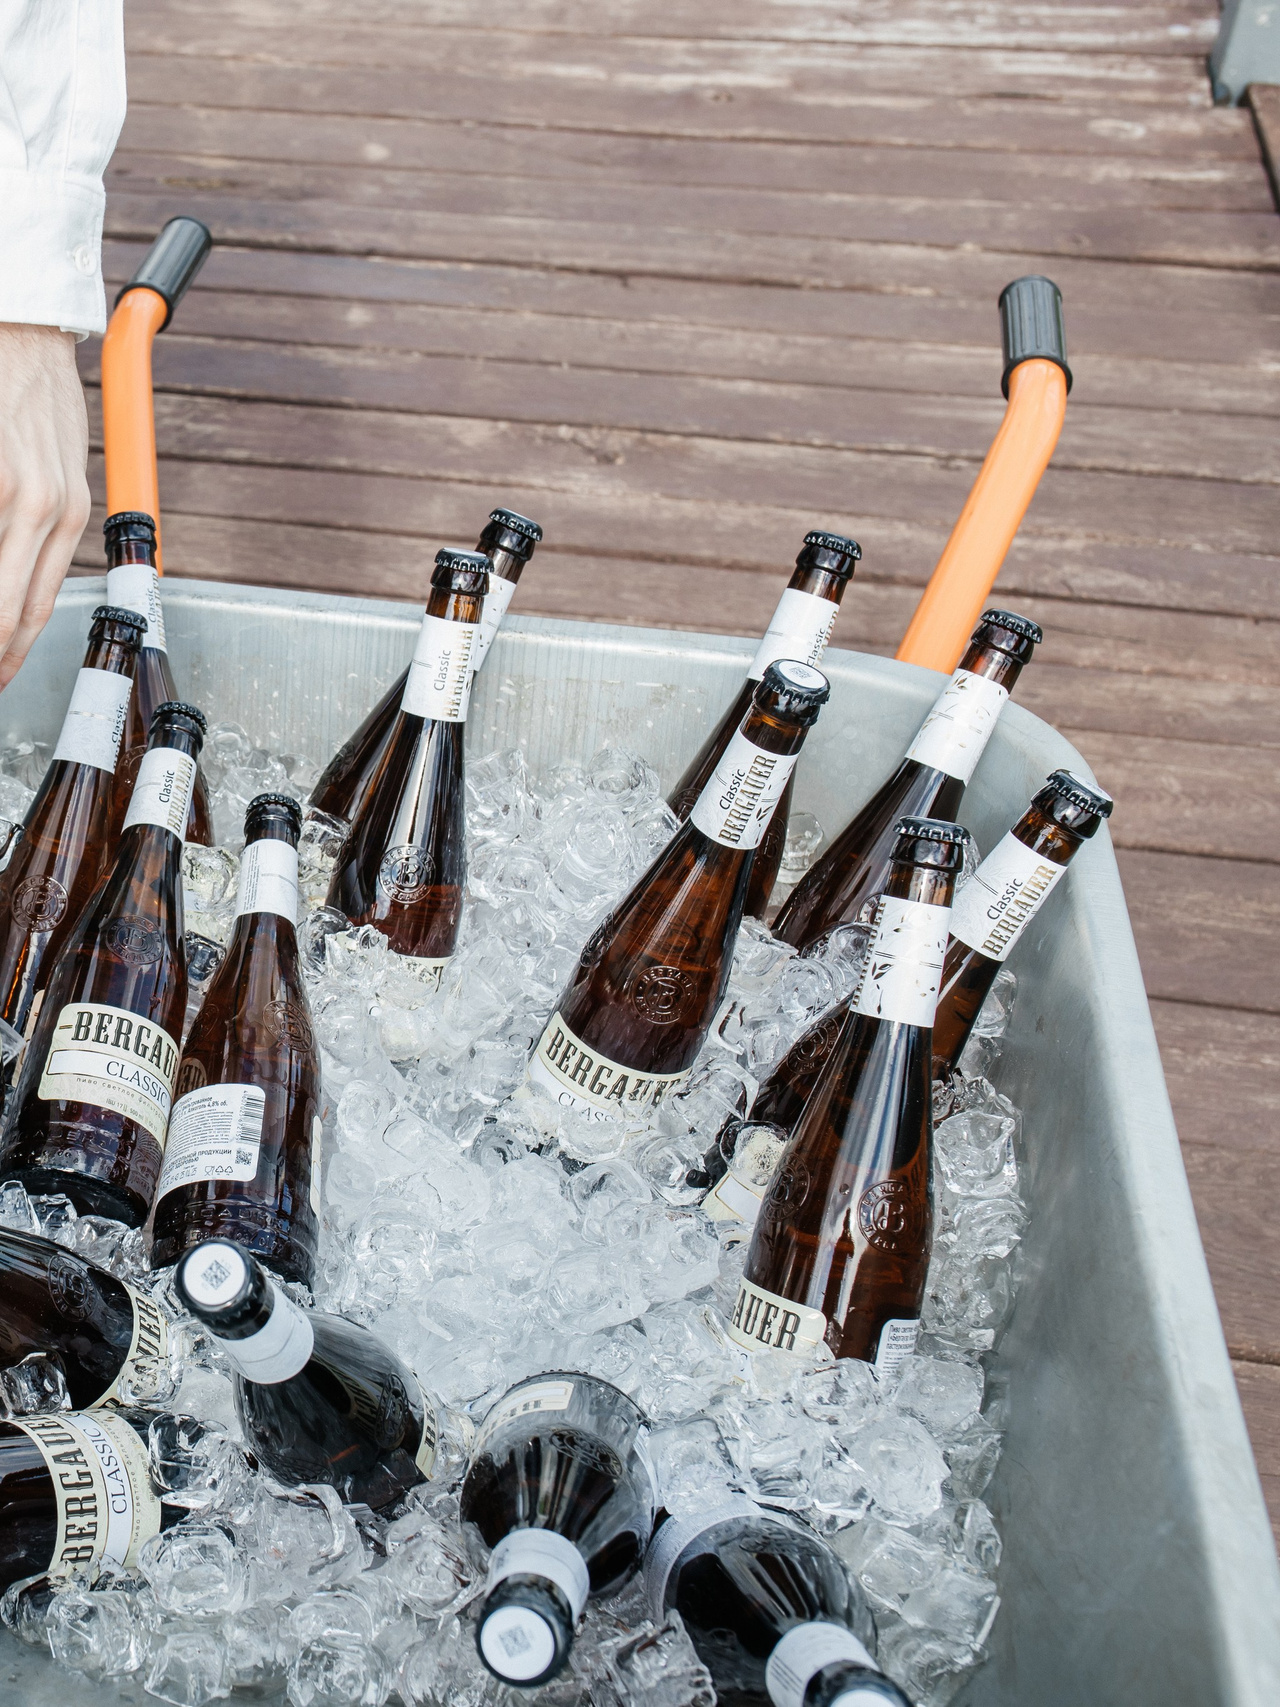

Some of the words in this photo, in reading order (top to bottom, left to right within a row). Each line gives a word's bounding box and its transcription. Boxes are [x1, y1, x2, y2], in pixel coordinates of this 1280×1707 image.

[146, 588, 157, 624] Classic
[806, 628, 826, 668] Classic
[433, 649, 452, 691] Classic
[111, 703, 126, 744] Classic
[158, 769, 176, 804] Classic
[717, 754, 778, 845] BERGAUER
[719, 768, 746, 811] Classic
[980, 864, 1058, 956] BERGAUER
[986, 878, 1024, 921] Classic
[77, 1077, 98, 1086] пиво
[106, 1060, 168, 1109] CLASSIC
[197, 1149, 232, 1157] ПРОДУКЦИИ
[83, 1427, 128, 1515] CLASSIC
[130, 1471, 141, 1514] светлое
[133, 1519, 141, 1543] пиво
